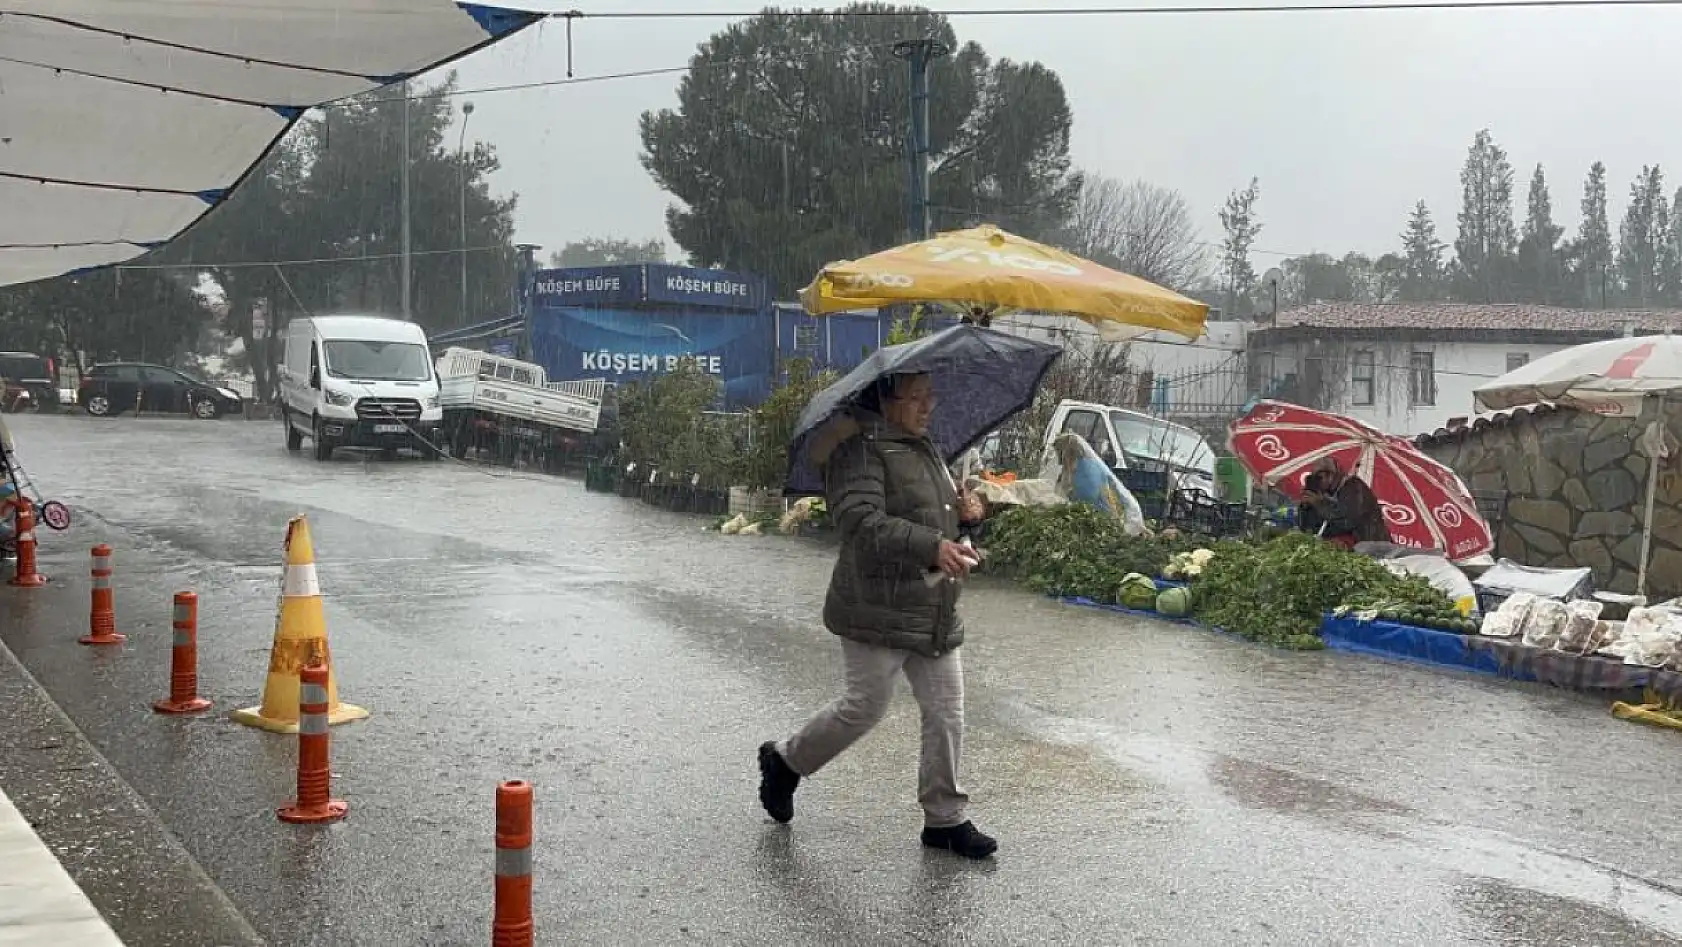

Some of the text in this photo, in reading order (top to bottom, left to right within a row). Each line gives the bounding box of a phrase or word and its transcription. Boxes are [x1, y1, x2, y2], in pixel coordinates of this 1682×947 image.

[536, 276, 620, 295] KÖŞEM BÜFE
[666, 276, 747, 296] KÖŞEM BÜFE
[582, 349, 658, 374] KÖŞEM
